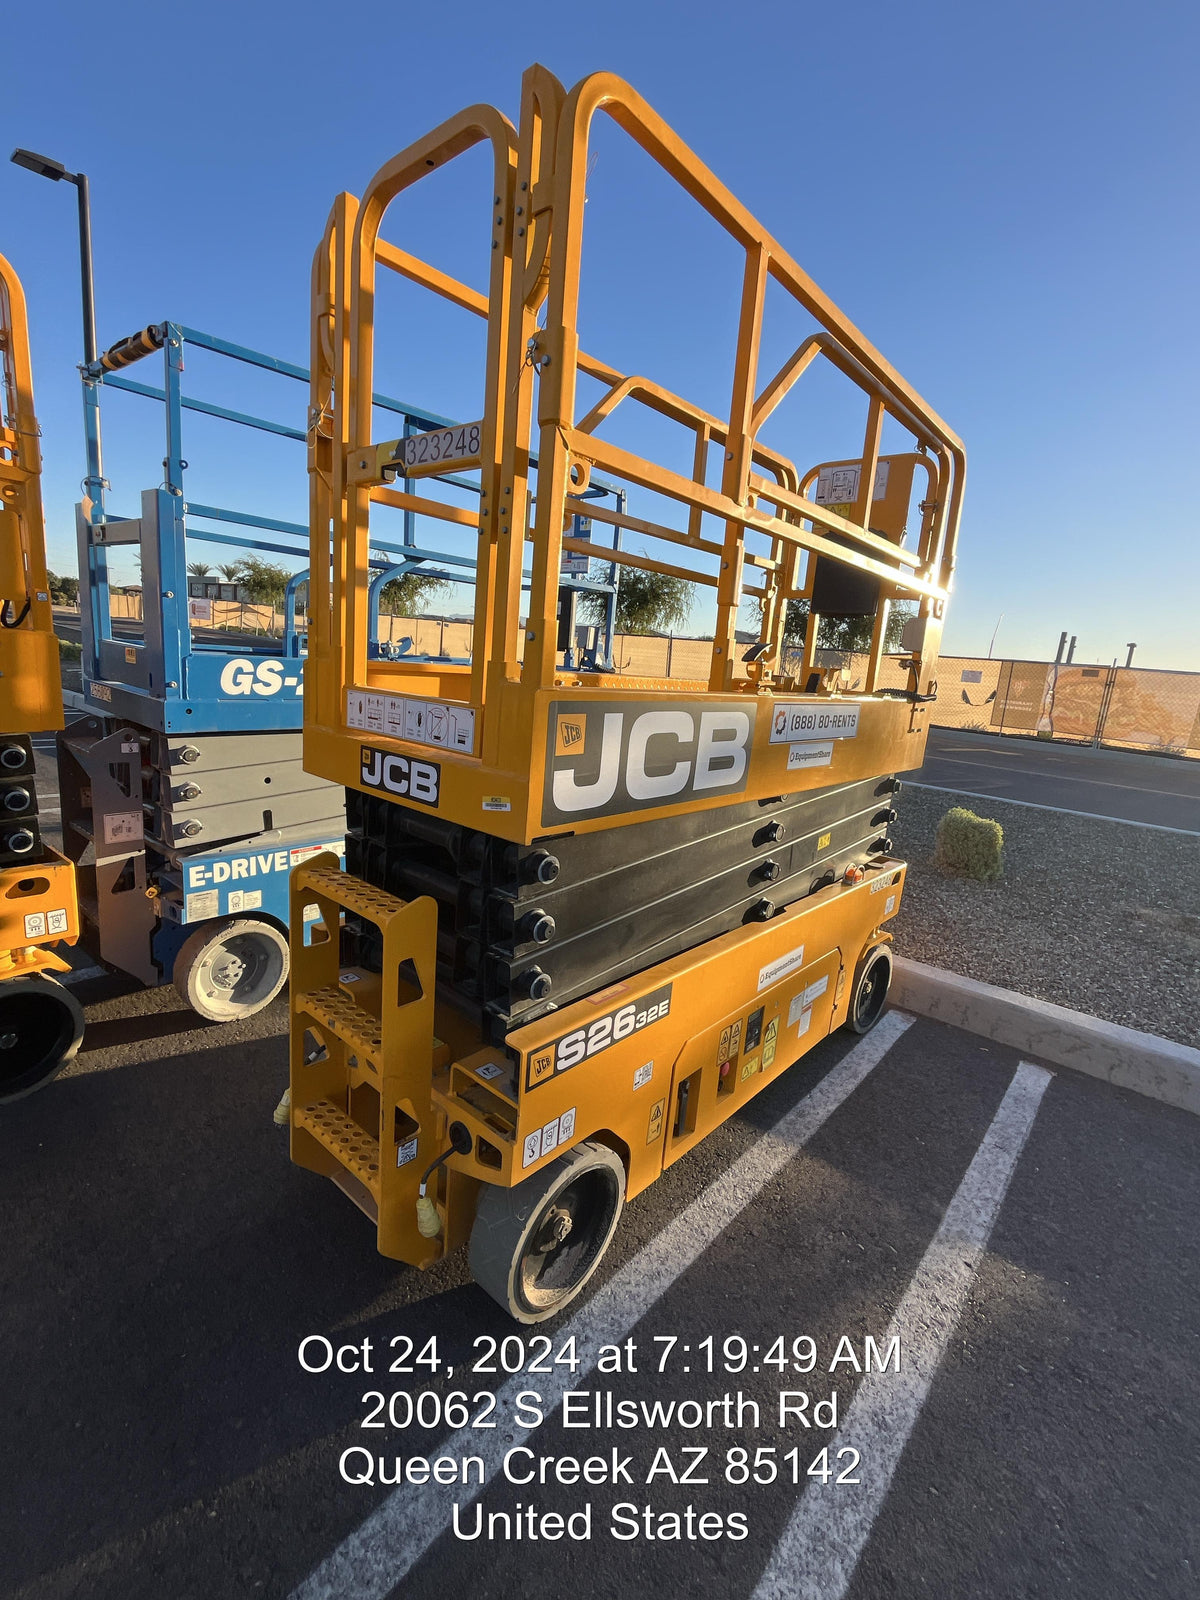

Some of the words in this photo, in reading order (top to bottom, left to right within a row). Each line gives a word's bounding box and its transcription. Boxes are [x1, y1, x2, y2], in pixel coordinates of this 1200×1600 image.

[407, 426, 479, 465] 323248
[564, 724, 581, 745] JCB
[791, 714, 816, 731] (888)
[818, 714, 857, 729] 80-RENTS
[552, 711, 750, 812] JCB
[795, 750, 831, 761] EquipmentShare
[362, 752, 438, 802] JCB
[189, 851, 288, 888] E-DRIVE
[535, 1056, 551, 1075] JCB
